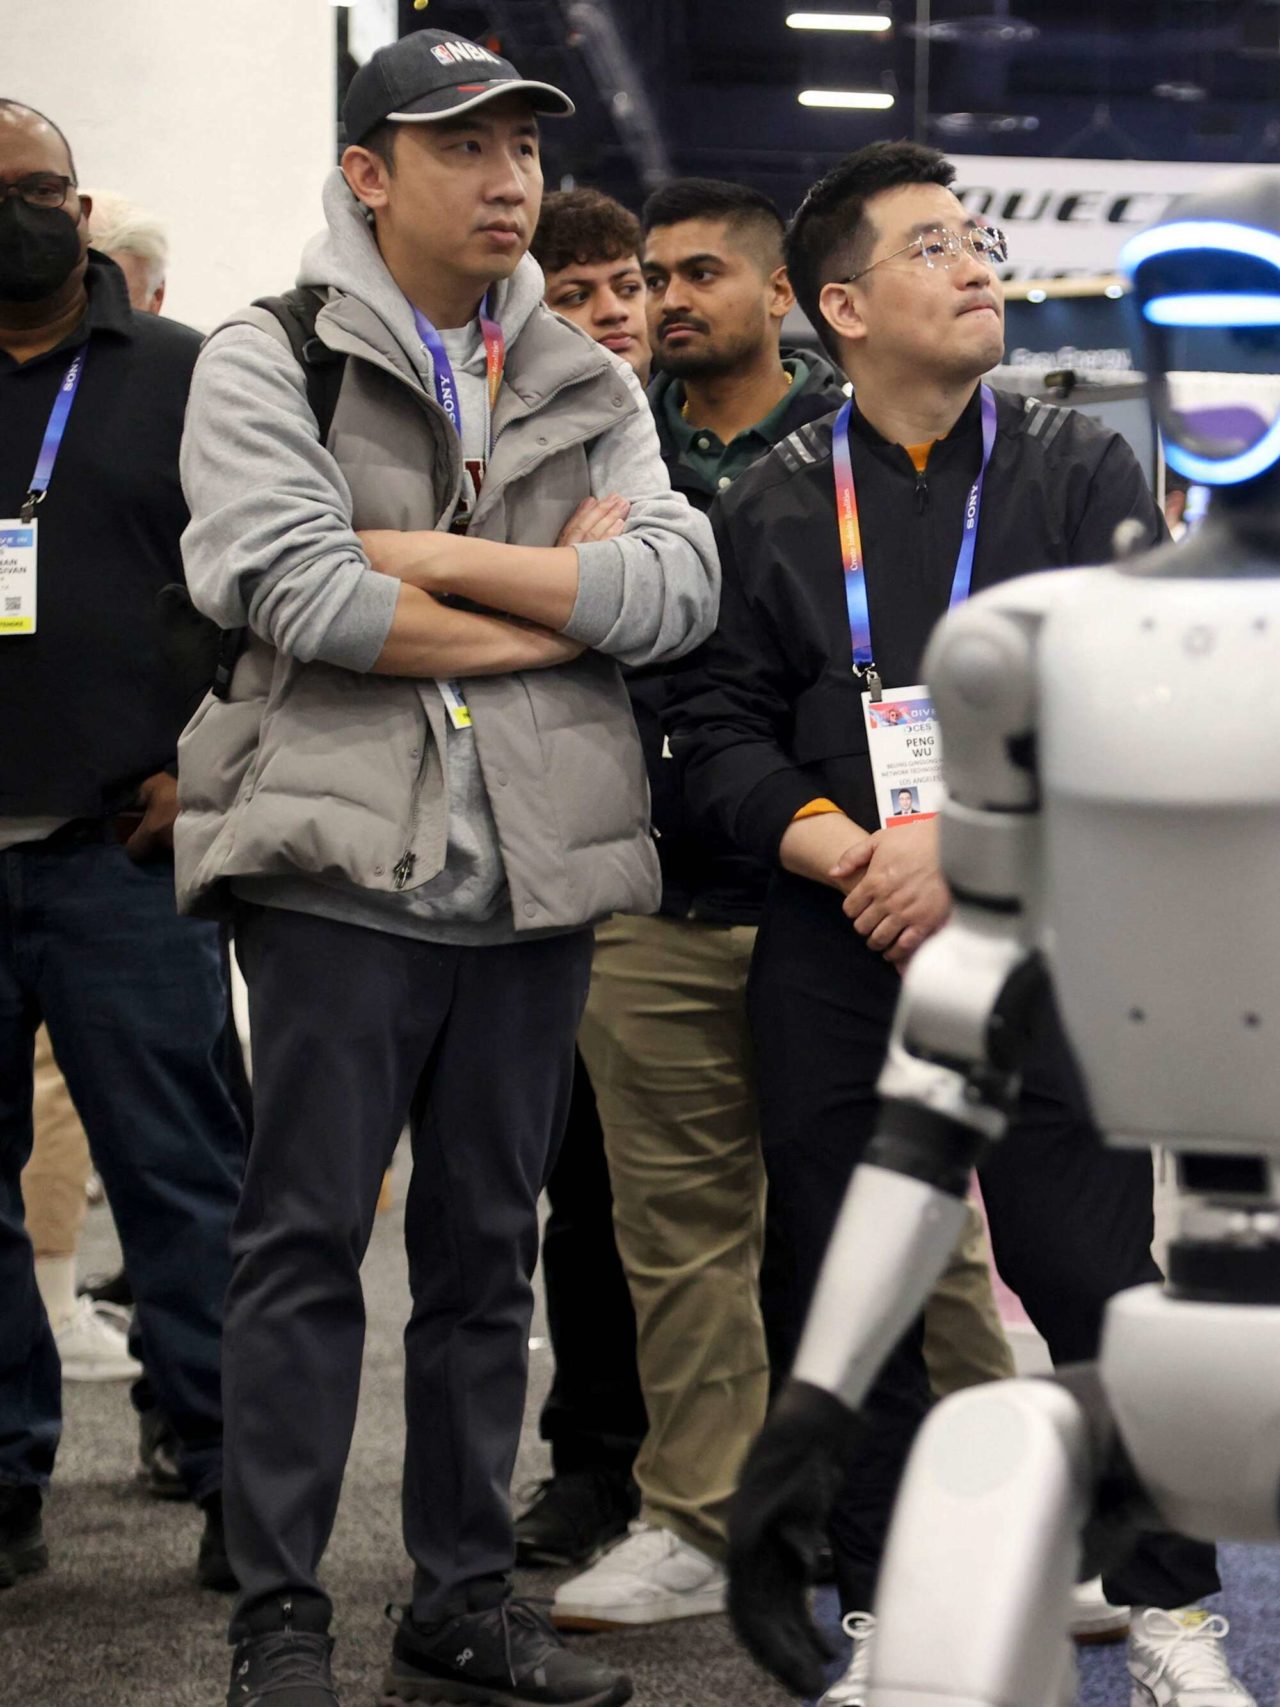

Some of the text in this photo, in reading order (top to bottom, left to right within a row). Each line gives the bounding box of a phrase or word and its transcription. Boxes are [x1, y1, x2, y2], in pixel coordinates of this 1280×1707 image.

[966, 484, 979, 530] SONY
[913, 724, 932, 732] CES
[906, 736, 935, 747] PENG
[912, 748, 932, 758] WU
